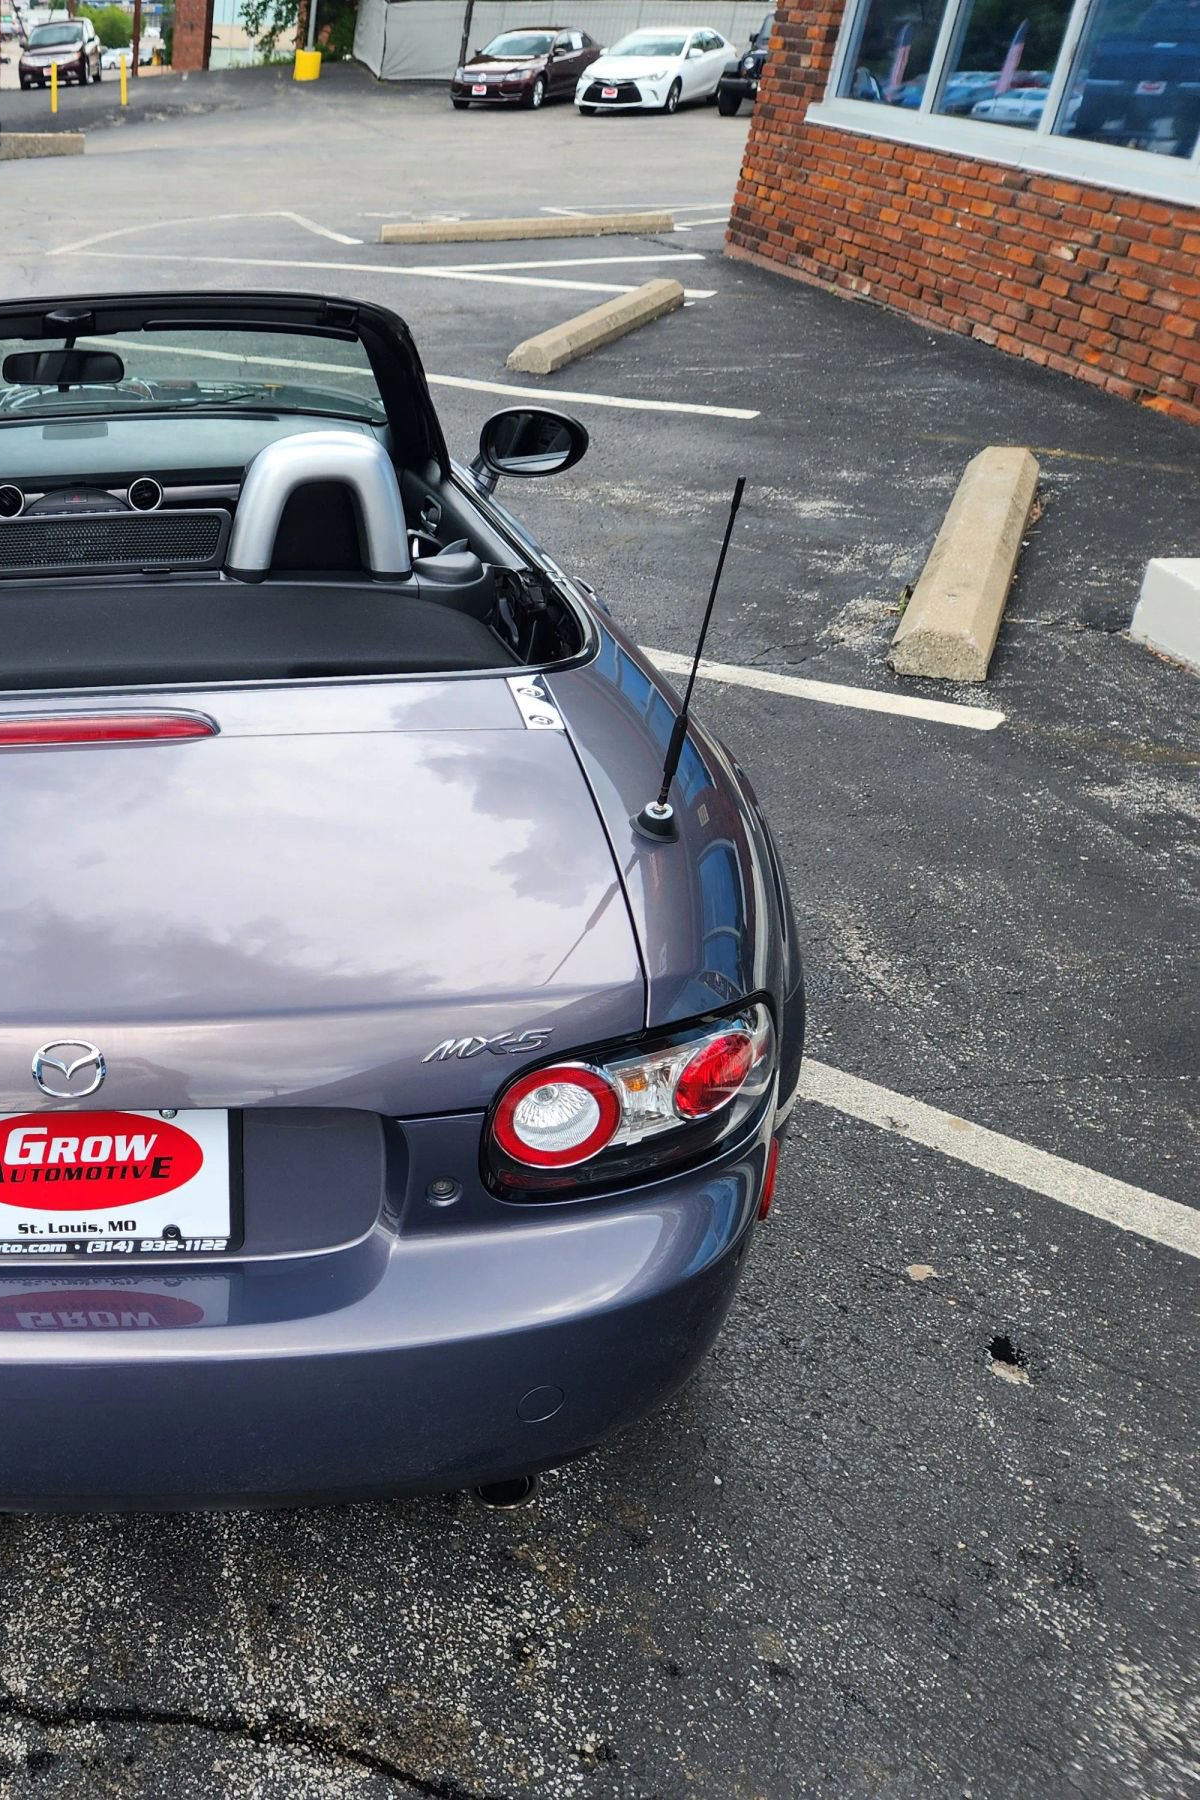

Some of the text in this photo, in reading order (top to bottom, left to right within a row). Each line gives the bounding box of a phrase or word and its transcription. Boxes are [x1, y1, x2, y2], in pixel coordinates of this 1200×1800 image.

[421, 1027, 556, 1063] MX-5
[18, 1220, 137, 1235] St. Louis, MO
[86, 1240, 134, 1254] (314)
[140, 1239, 228, 1252] 932-1122
